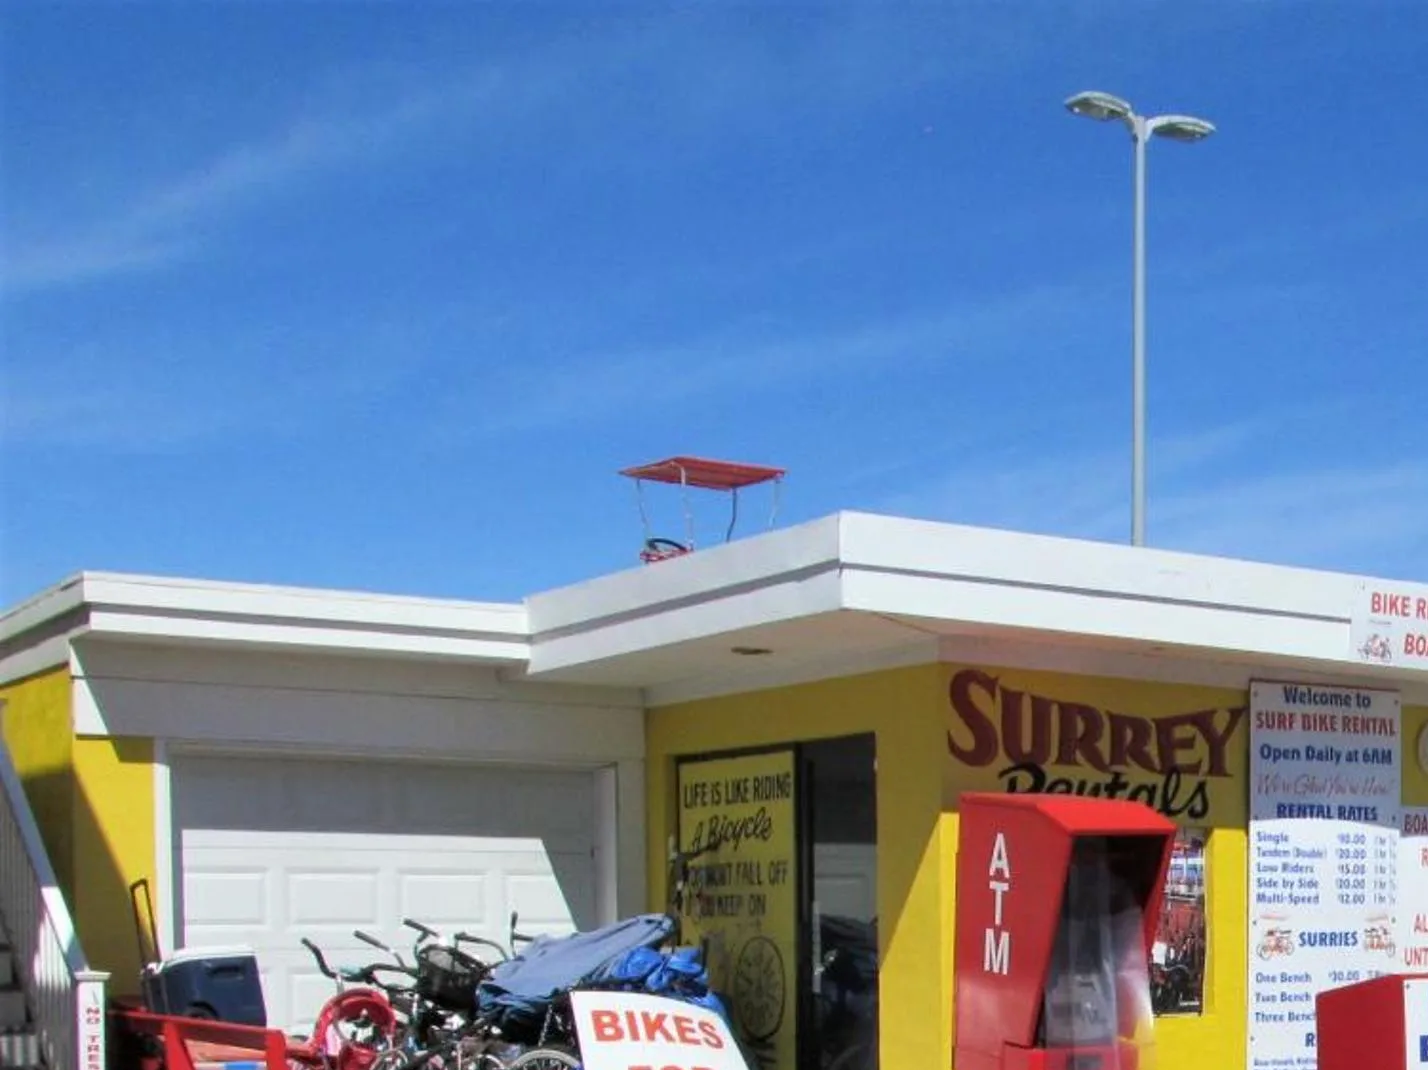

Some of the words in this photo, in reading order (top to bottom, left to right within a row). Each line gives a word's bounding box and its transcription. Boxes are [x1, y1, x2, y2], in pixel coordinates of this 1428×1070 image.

[1371, 592, 1410, 617] BIKE
[1283, 685, 1353, 708] Welcome
[1356, 692, 1372, 708] to
[947, 669, 1248, 778] SURREY
[1256, 710, 1296, 730] SURF
[1301, 712, 1338, 732] BIKE
[1342, 715, 1396, 737] RENTAL
[1259, 743, 1300, 764] Open
[1305, 745, 1341, 766] Daily
[1345, 748, 1358, 762] at
[1362, 748, 1392, 765] 6AM
[684, 781, 708, 809] LIFE
[710, 781, 721, 806] IS
[725, 777, 750, 805] LIKE
[753, 772, 791, 802] RIDING
[1277, 802, 1332, 820] RENTAL
[1337, 806, 1377, 822] RATES
[692, 820, 704, 851] A
[707, 806, 772, 851] Bicycle
[1257, 831, 1289, 845] Single
[735, 860, 763, 886] FALL
[768, 859, 788, 885] OFF
[1257, 862, 1278, 873] Low
[1281, 862, 1314, 873] Riders
[1257, 878, 1278, 889] Side
[1282, 878, 1294, 890] by
[1298, 878, 1319, 889] Side
[748, 893, 766, 915] ON
[984, 832, 1010, 975] ATM
[1256, 893, 1319, 905] Multi-Speed
[1298, 931, 1358, 947] SURRIES
[1255, 972, 1277, 984] One
[1280, 971, 1312, 983] Bench
[1255, 991, 1277, 1002] Two
[1280, 991, 1311, 1002] Bench
[86, 1007, 100, 1025] NO
[1255, 1012, 1284, 1022] Three
[590, 1010, 724, 1049] BIKES
